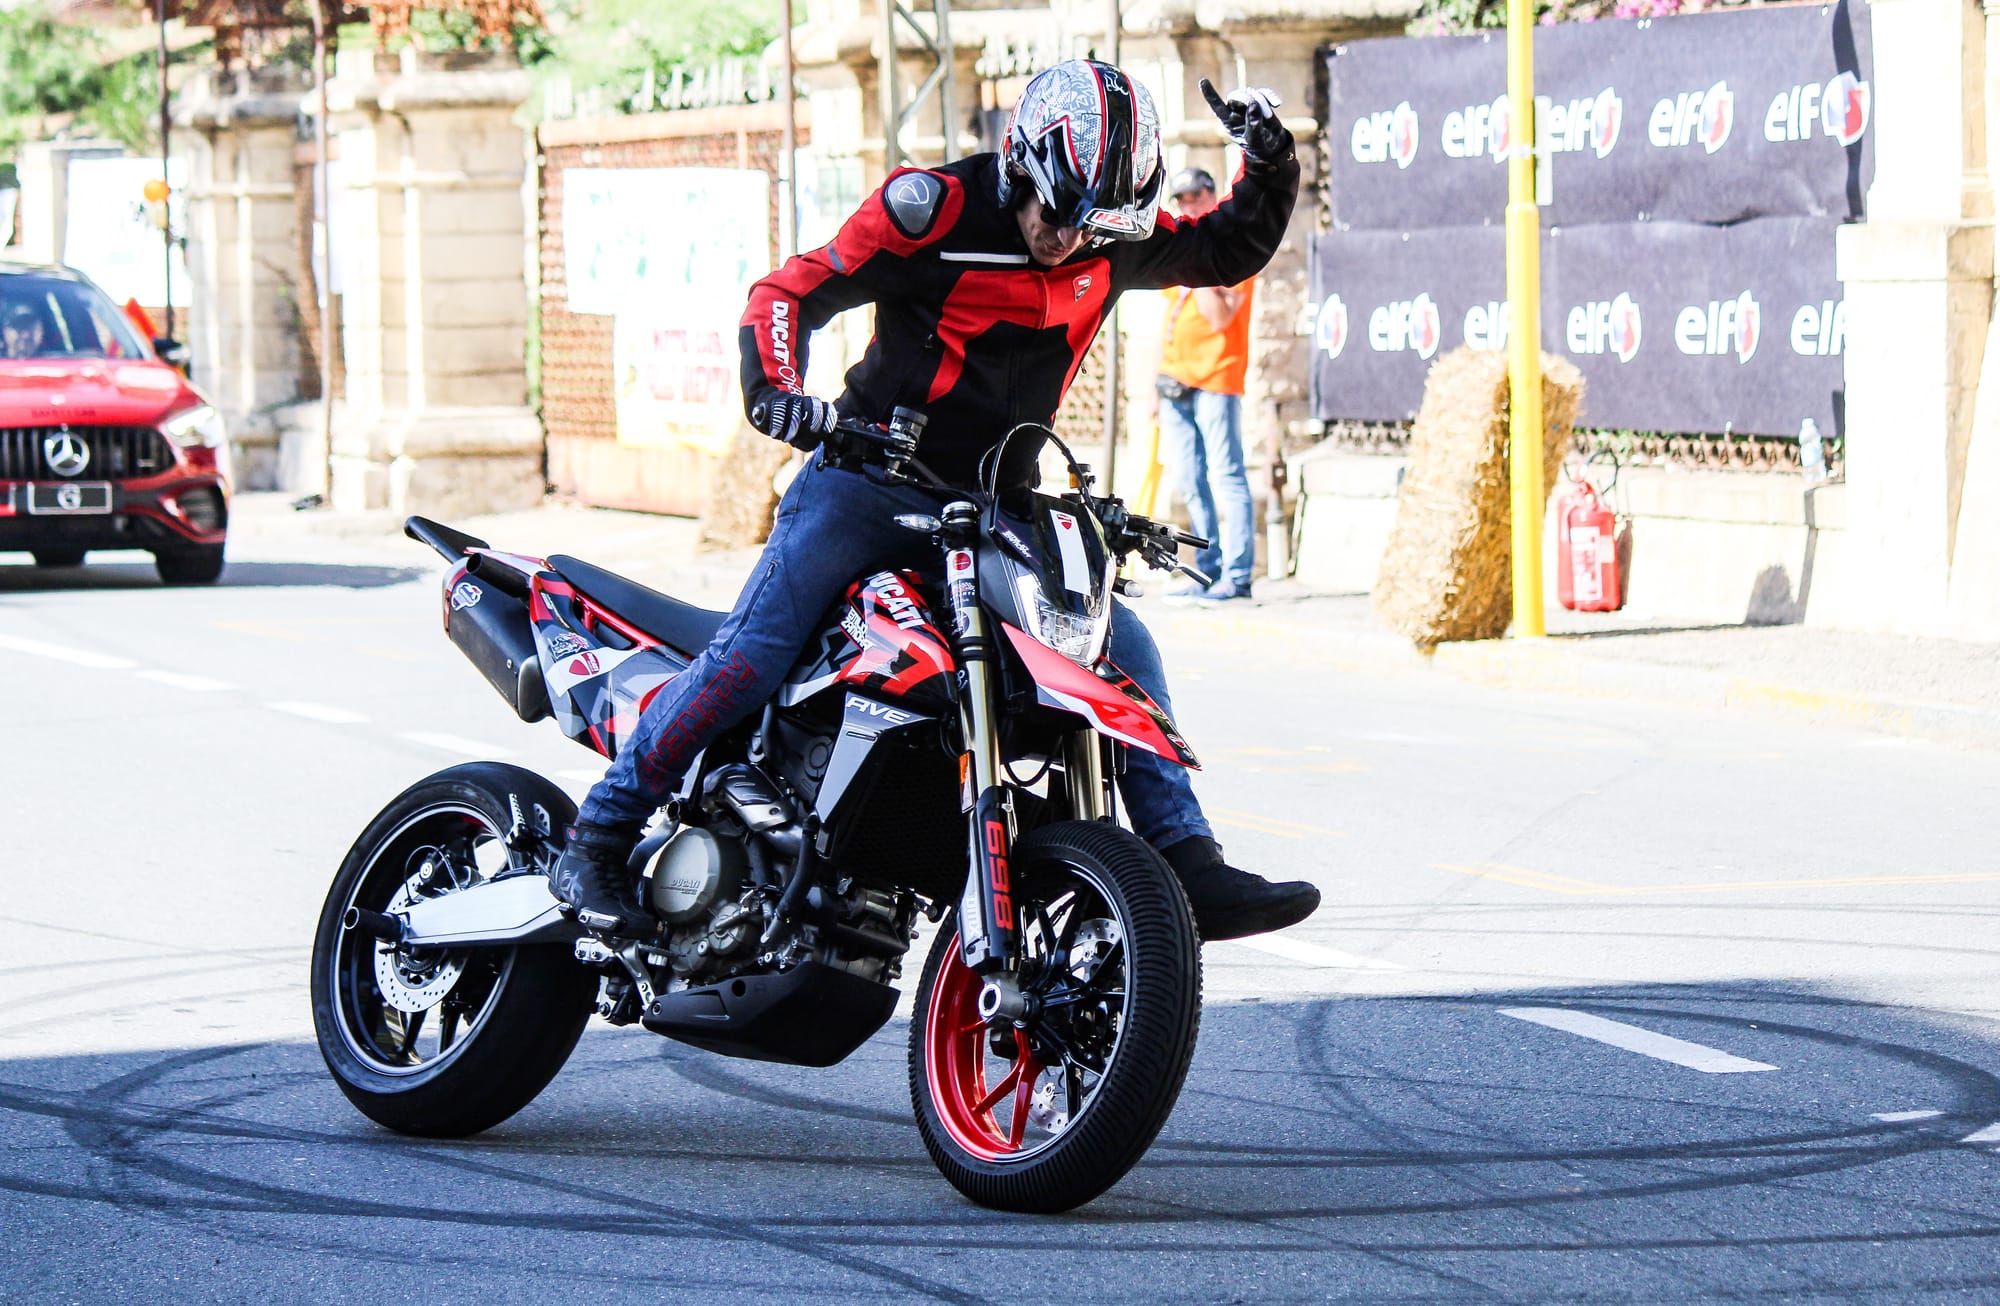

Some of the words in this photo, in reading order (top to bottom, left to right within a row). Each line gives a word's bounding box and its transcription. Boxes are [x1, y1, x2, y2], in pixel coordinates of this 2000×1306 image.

[1764, 83, 1820, 142] elf
[864, 570, 926, 631] UCATI
[986, 820, 1014, 931] 698
